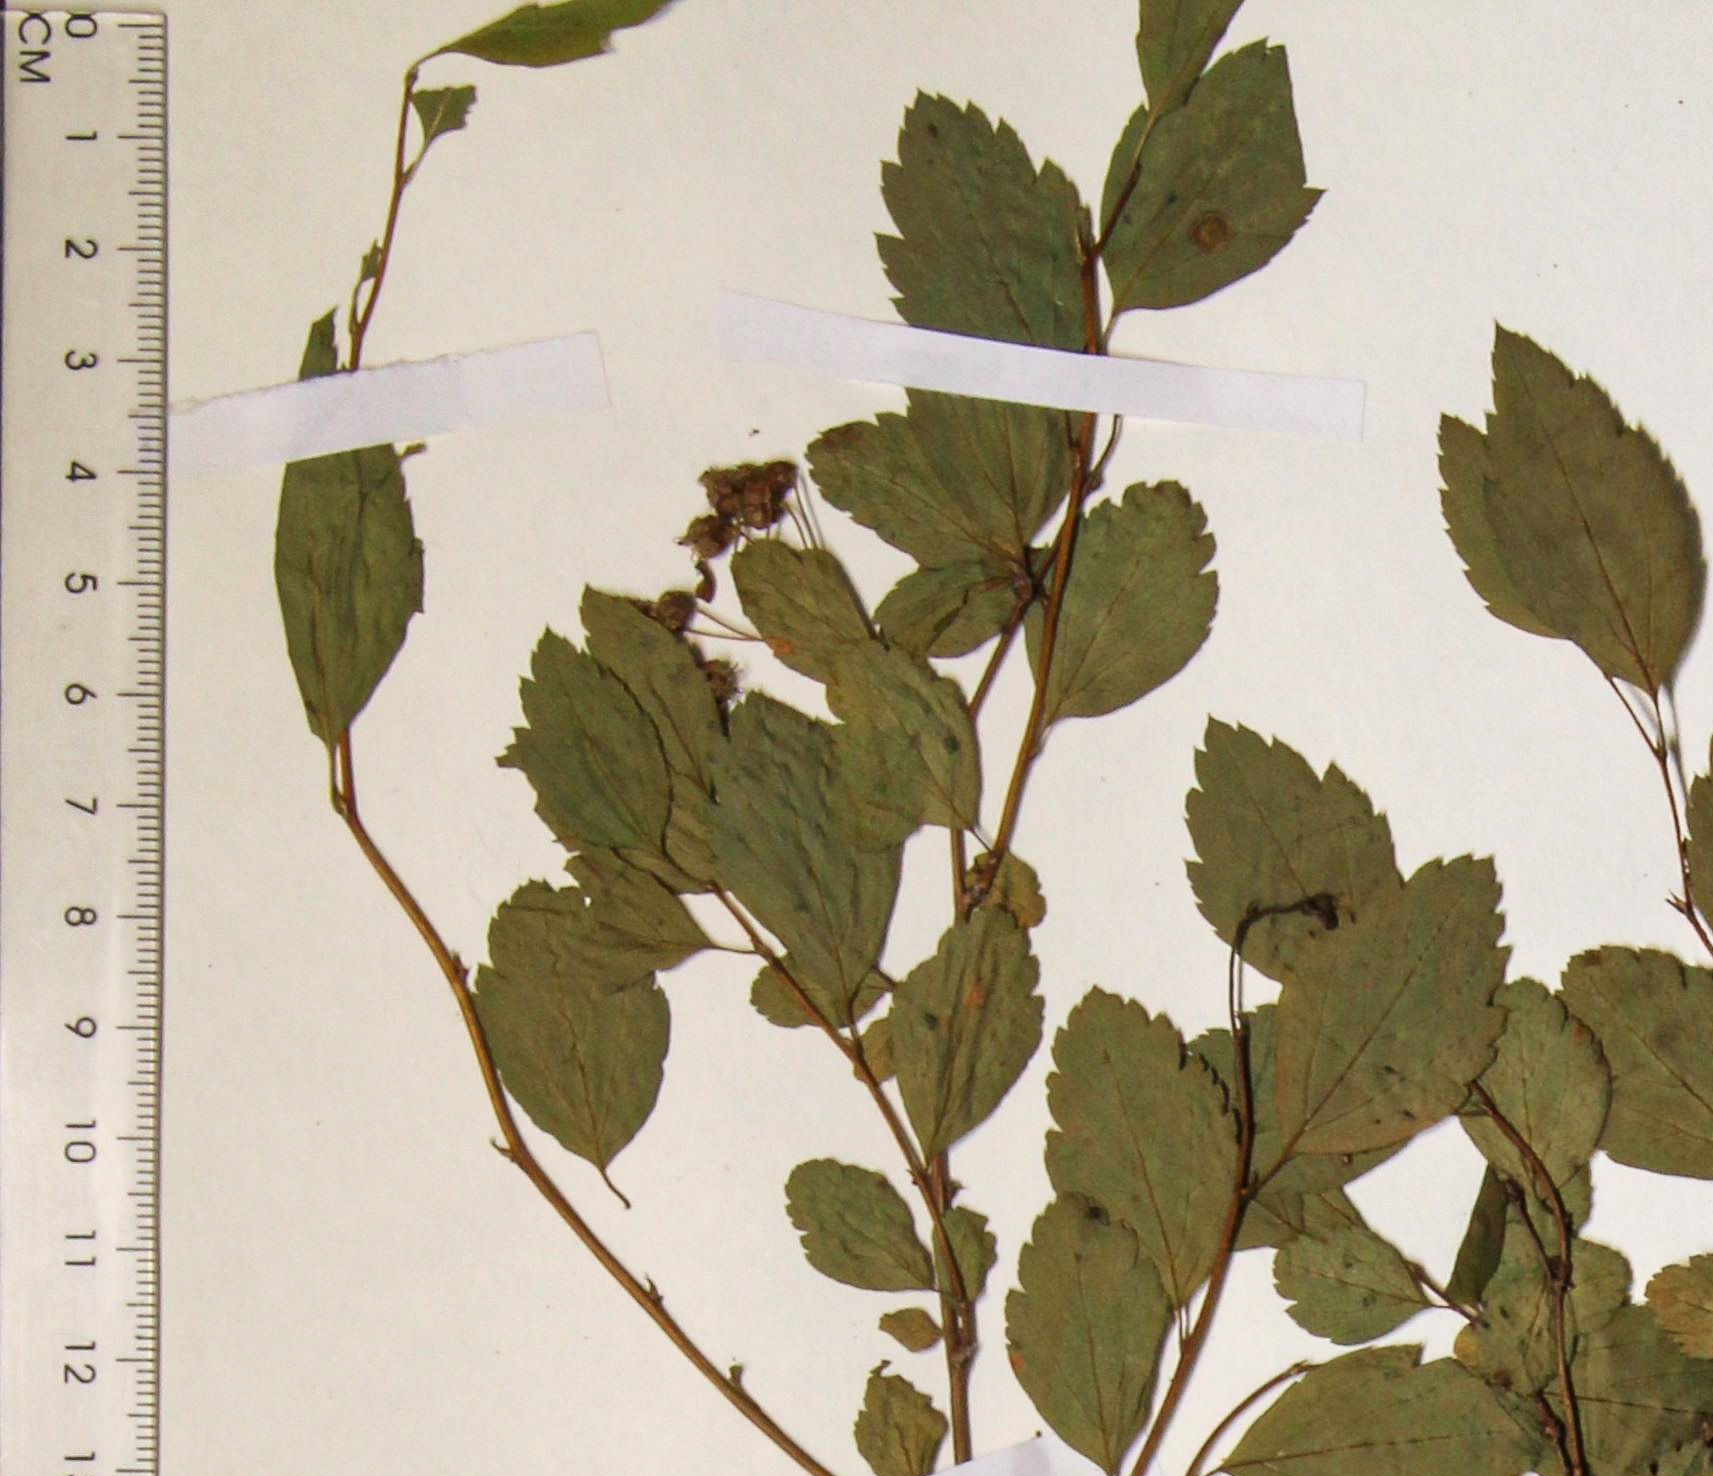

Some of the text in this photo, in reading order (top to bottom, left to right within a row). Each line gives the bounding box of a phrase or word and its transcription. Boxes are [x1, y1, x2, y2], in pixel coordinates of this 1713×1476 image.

[64, 12, 99, 40] 0
[19, 12, 52, 84] CM
[64, 130, 99, 142] 1
[64, 238, 100, 260] 2
[63, 349, 100, 372] 3
[64, 459, 99, 483] 4
[63, 571, 99, 595] 5
[63, 682, 98, 706] 6
[64, 797, 99, 816] 7
[63, 905, 99, 928] 8
[63, 1015, 98, 1040] 9
[63, 1119, 98, 1164] 10
[64, 1229, 97, 1267] 11
[63, 1340, 97, 1385] 12
